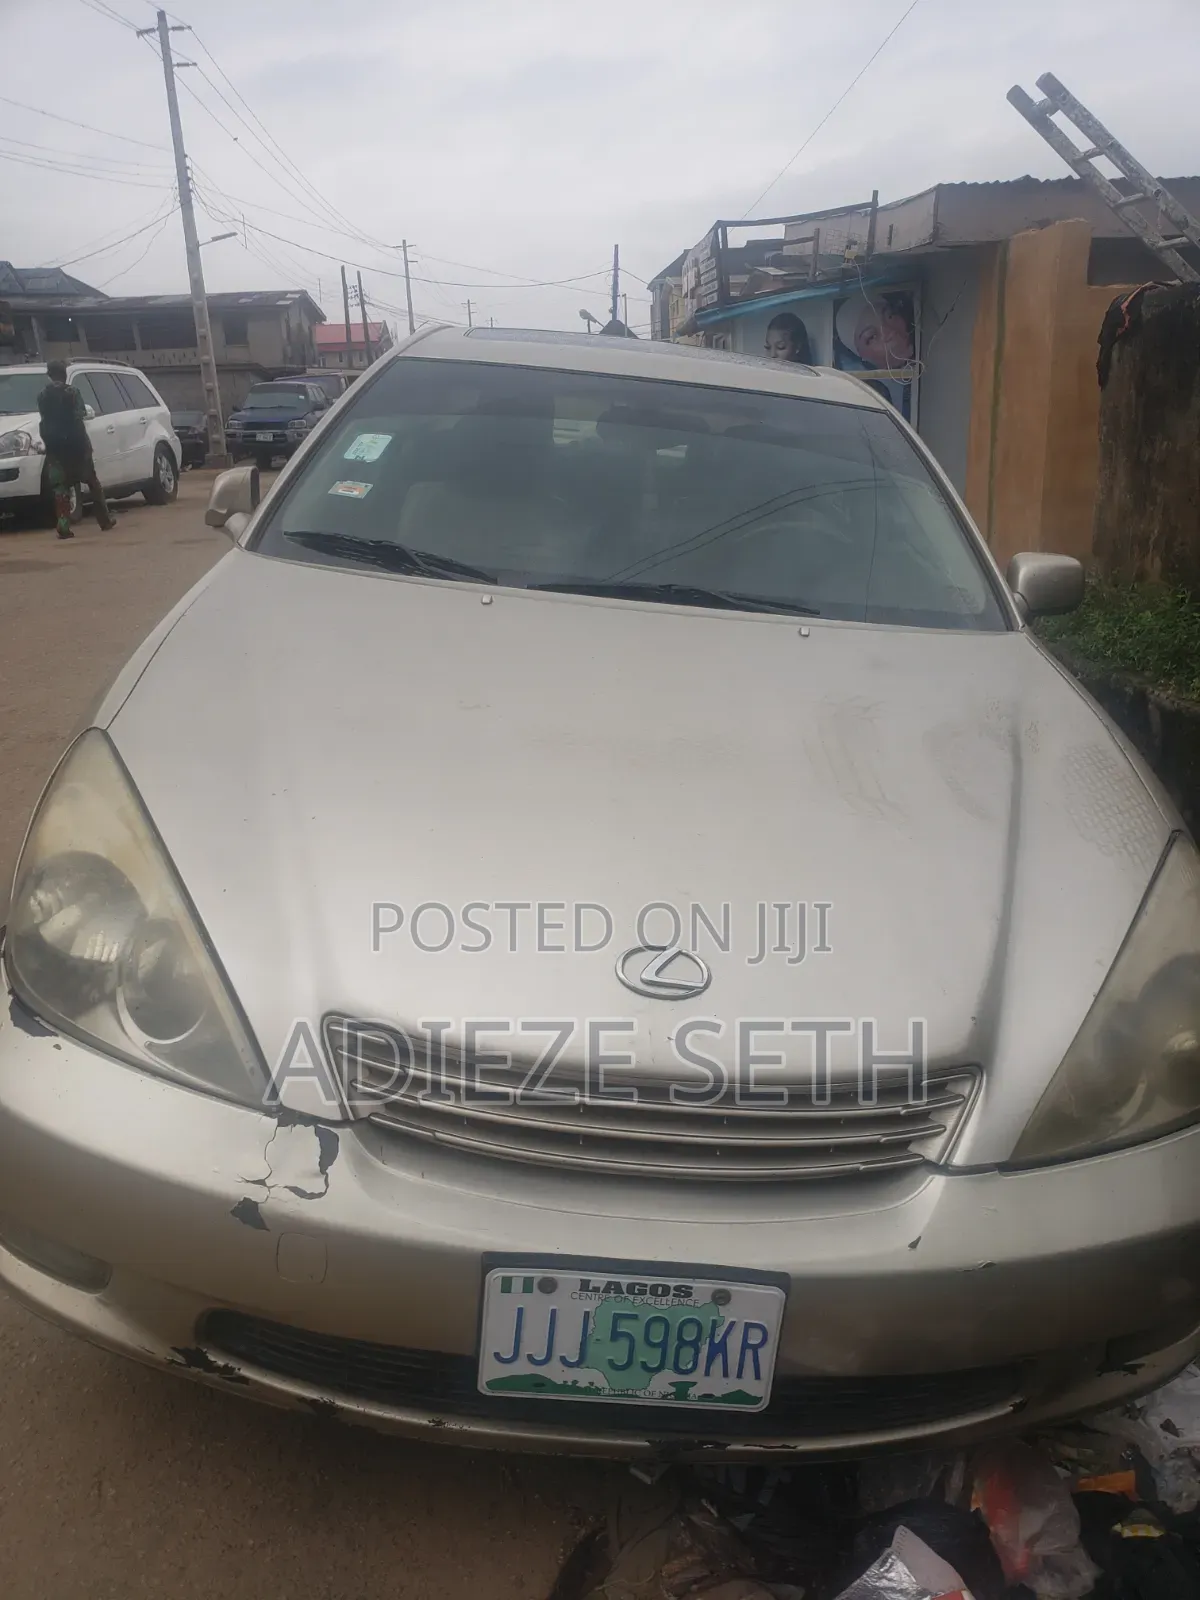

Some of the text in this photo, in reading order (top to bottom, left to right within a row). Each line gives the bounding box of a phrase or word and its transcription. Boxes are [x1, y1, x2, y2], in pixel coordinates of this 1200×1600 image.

[578, 1279, 693, 1299] LAGOS
[570, 1291, 700, 1308] CENTRE OF EXCELLENCE
